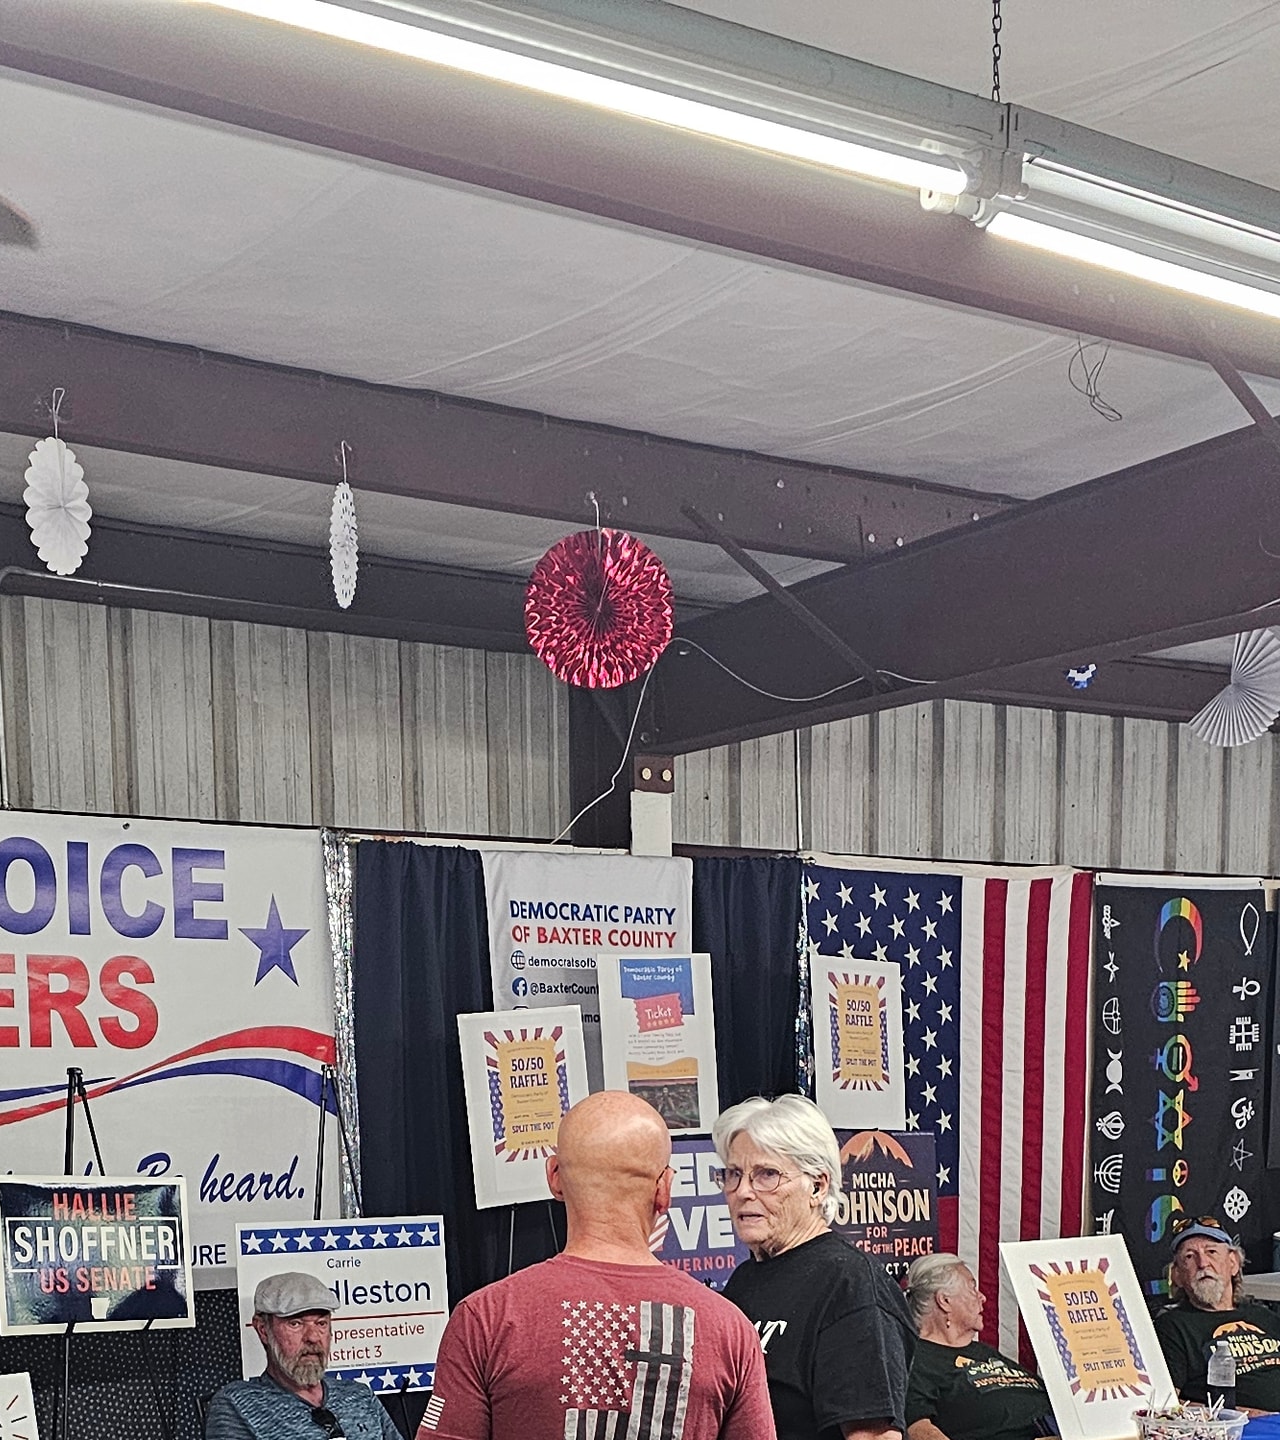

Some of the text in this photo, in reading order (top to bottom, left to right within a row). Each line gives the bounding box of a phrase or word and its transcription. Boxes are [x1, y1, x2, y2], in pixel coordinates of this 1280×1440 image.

[509, 900, 676, 925] DEMOCRATIC PARTY
[511, 924, 677, 948] OF BAXTER COUNTY
[645, 1005, 672, 1019] Ticket
[846, 999, 871, 1012] 50/50
[845, 1014, 874, 1027] RAFFLE
[511, 1057, 544, 1072] 50/50
[510, 1073, 548, 1088] RAFFLE
[512, 1122, 555, 1134] SPLIT THE POT
[200, 1153, 305, 1203] heard.
[670, 1152, 727, 1197] ED
[852, 1172, 896, 1189] MICHA
[52, 1192, 136, 1221] HALLIE
[834, 1189, 930, 1226] OHNSON
[667, 1205, 735, 1251] VE
[866, 1226, 887, 1238] FOR
[14, 1225, 176, 1264] SHOFFNER
[894, 1237, 933, 1256] PEACE
[326, 1256, 361, 1269] Carrie
[663, 1255, 736, 1271] VERNOR
[40, 1265, 157, 1294] US SENATE
[328, 1279, 431, 1306] dleston
[1064, 1290, 1099, 1306] 50/50
[1067, 1307, 1108, 1324] RAFFLE
[331, 1322, 425, 1344] presentative
[1227, 1334, 1259, 1343] MICHA
[328, 1345, 382, 1362] istrict 3
[1243, 1355, 1259, 1363] FOR
[1083, 1359, 1127, 1372] SPLIT THE POT
